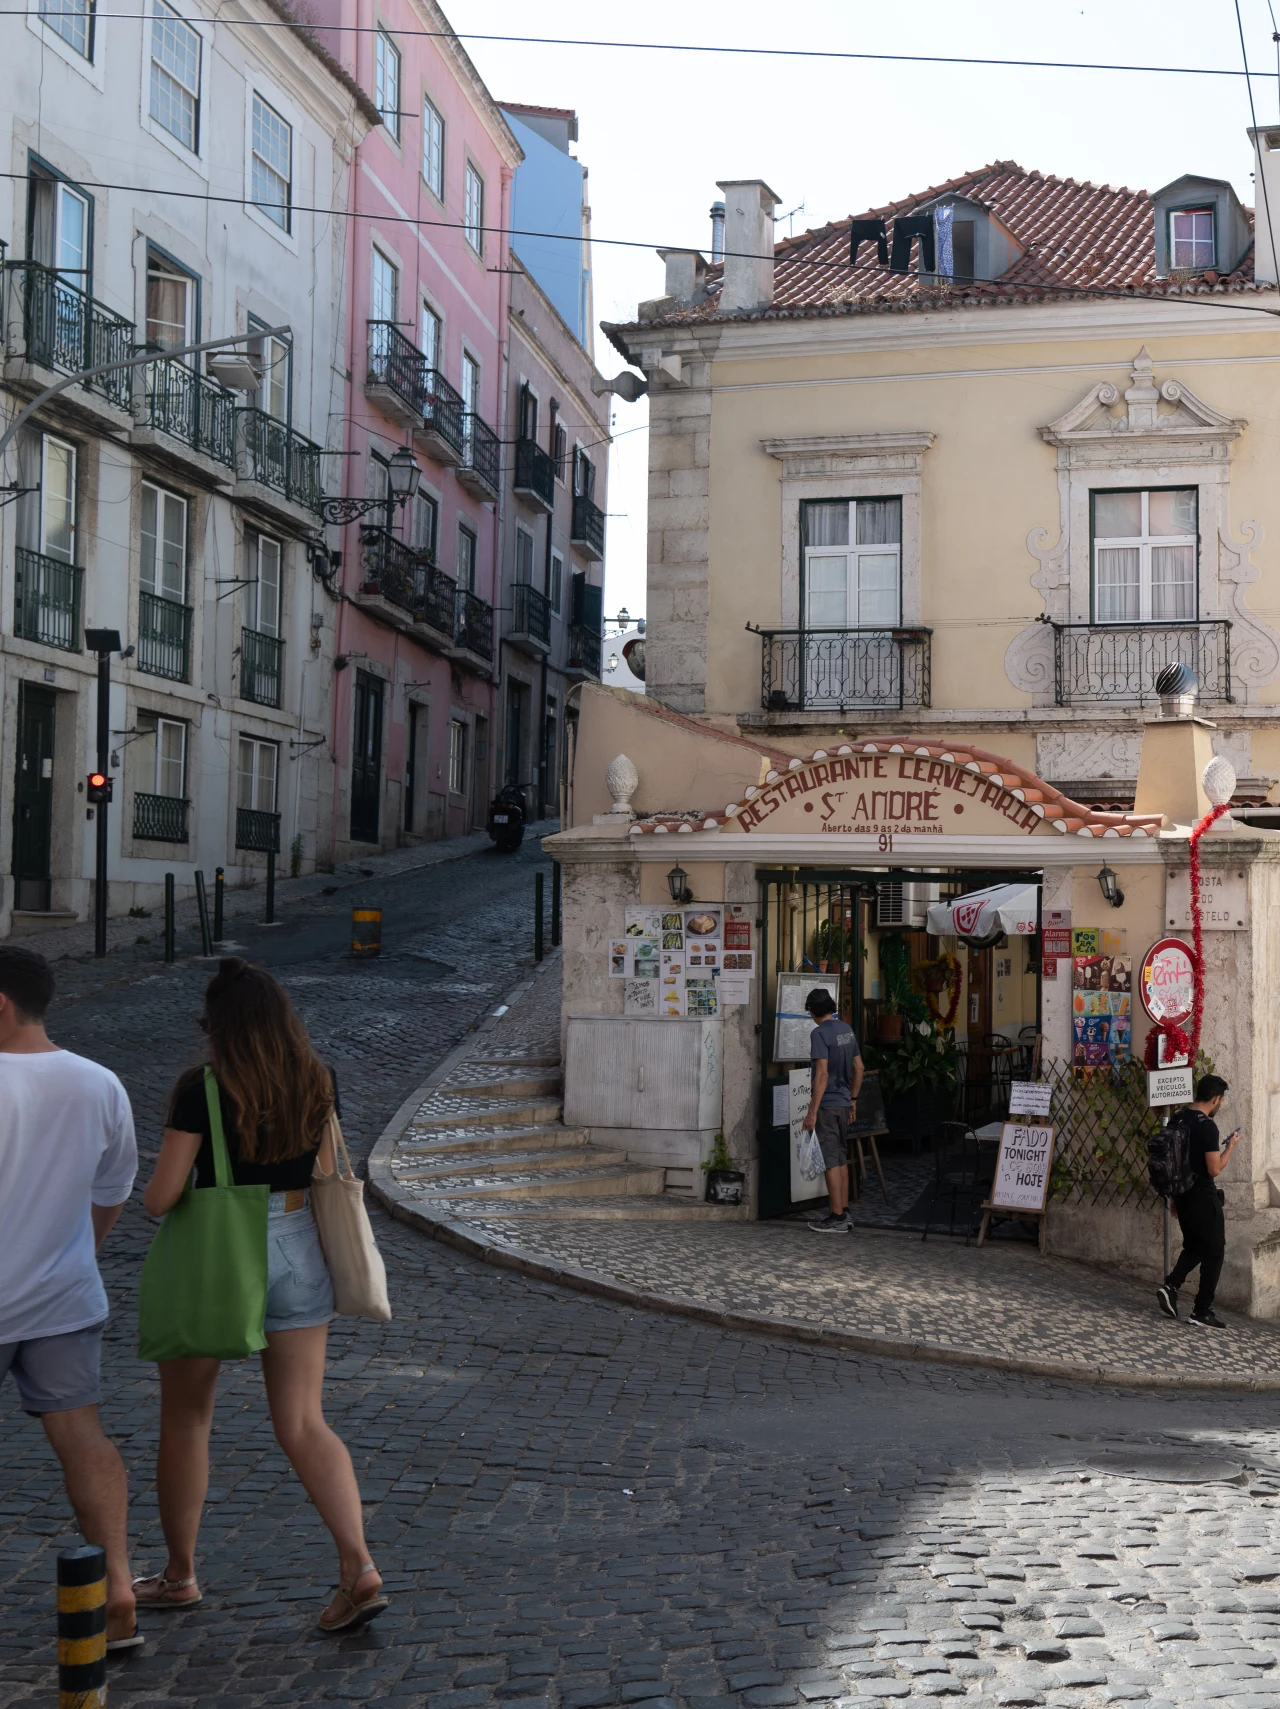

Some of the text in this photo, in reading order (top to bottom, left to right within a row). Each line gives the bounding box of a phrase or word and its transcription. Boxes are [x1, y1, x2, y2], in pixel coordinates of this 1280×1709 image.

[737, 756, 1042, 835] RESTAURANTE CERVEJARIA
[851, 787, 942, 821] ANDRÉ
[821, 822, 943, 834] Aberto das 9 as 2 da manhã
[878, 834, 893, 852] 91
[1198, 877, 1223, 887] OSTA
[1201, 894, 1213, 904] DO
[1185, 911, 1230, 921] CSTELO
[1157, 1076, 1185, 1084] EXCEPTO
[1156, 1083, 1186, 1091] VEÍCULOS
[1151, 1090, 1192, 1099] AUTORIZADOS
[1011, 1127, 1048, 1148] FADO
[1004, 1147, 1047, 1162] TONIGHT
[1016, 1173, 1044, 1188] HOJE
